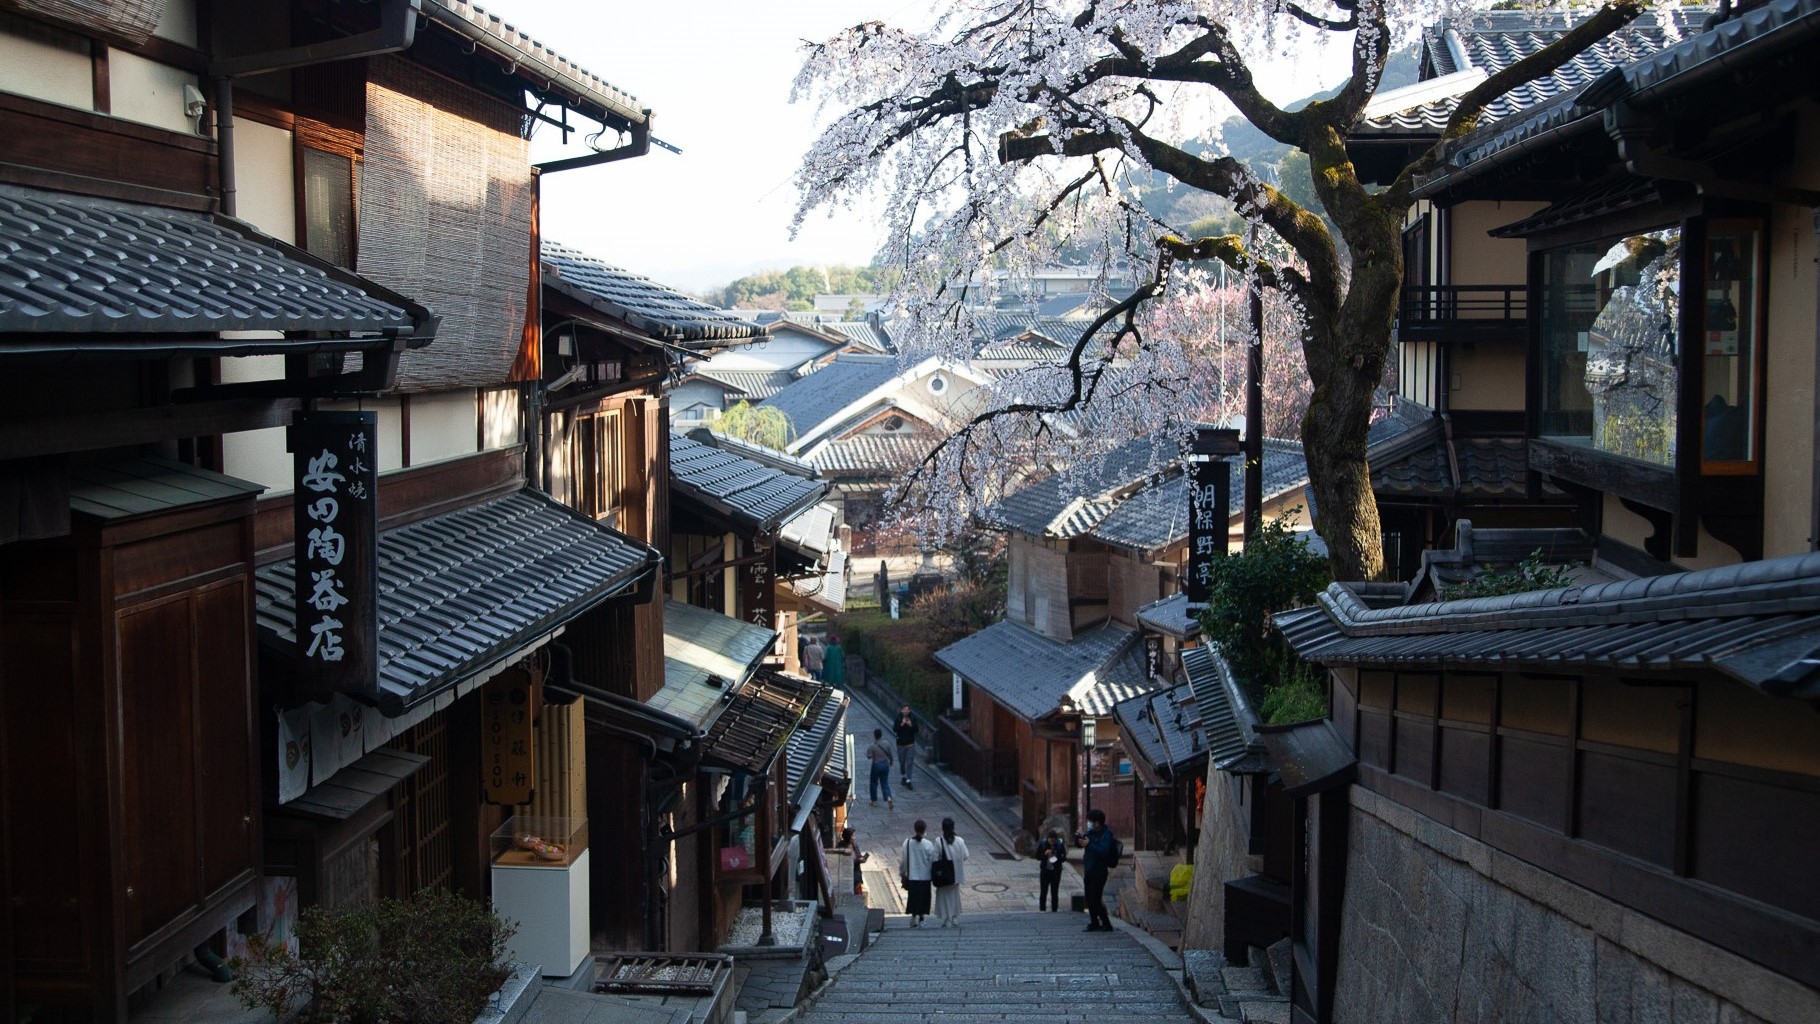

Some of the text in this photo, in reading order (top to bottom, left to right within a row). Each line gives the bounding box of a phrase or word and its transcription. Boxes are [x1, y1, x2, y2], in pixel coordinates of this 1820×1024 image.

[348, 433, 370, 500] 清水焼
[302, 448, 348, 662] 安田陶器店
[1195, 484, 1215, 585] 明保野亭
